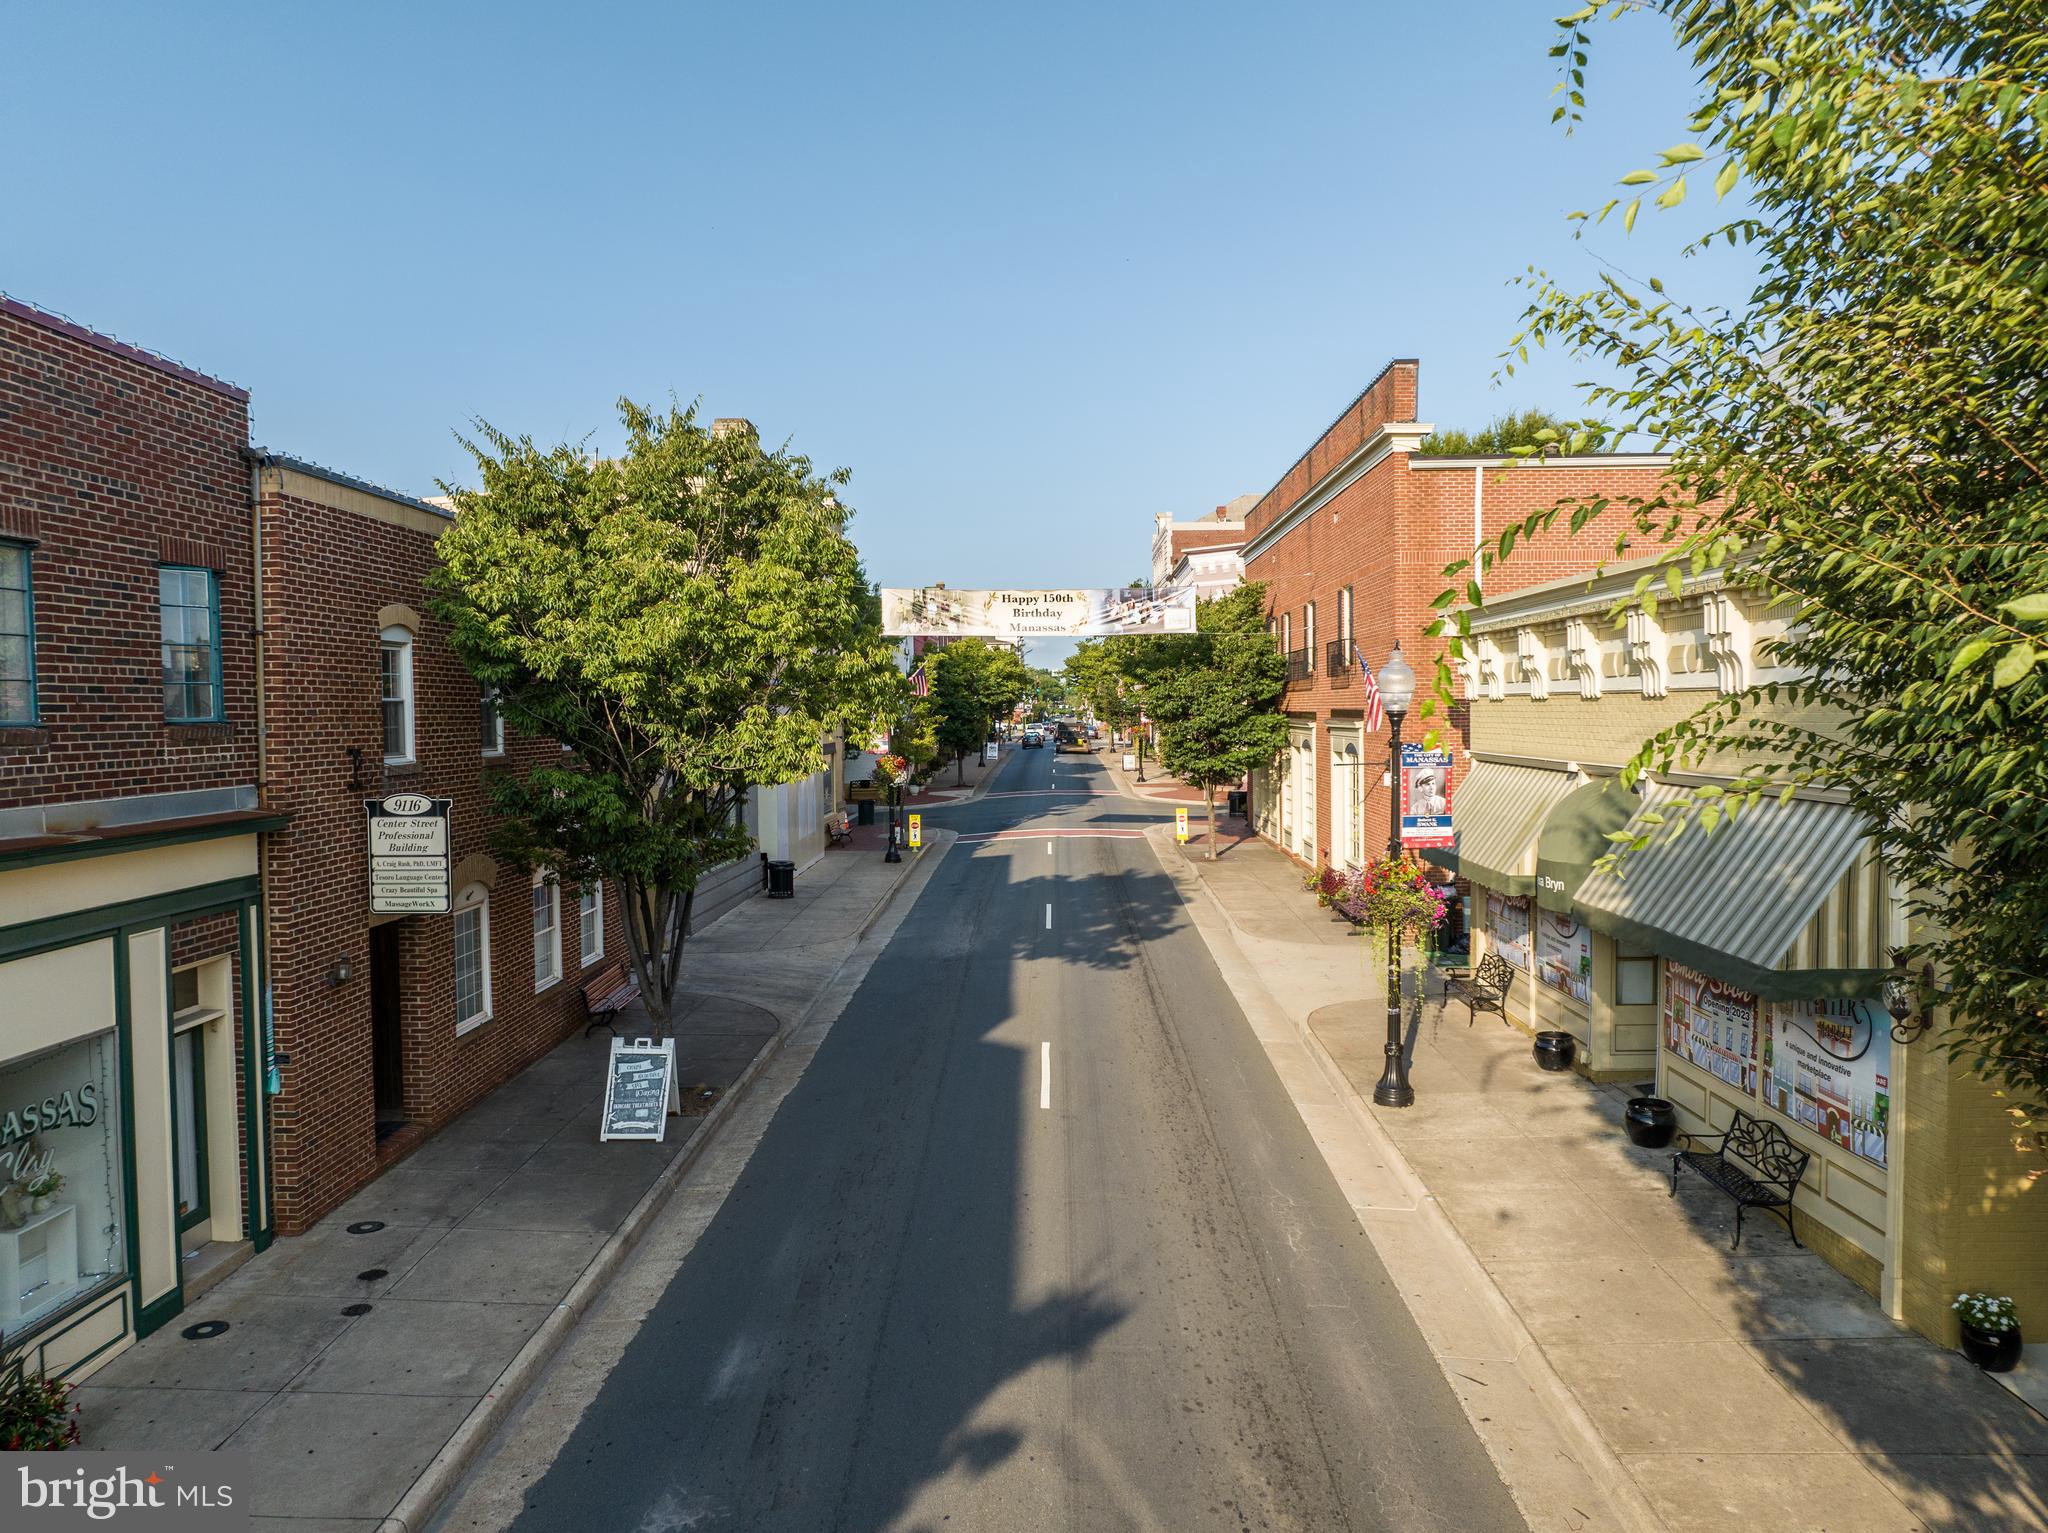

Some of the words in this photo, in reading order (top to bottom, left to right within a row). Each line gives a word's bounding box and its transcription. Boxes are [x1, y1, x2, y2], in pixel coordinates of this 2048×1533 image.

[1002, 594, 1039, 605] Happy
[1044, 594, 1073, 603] 150th
[1013, 608, 1063, 620] Birthday
[1009, 622, 1066, 632] Manassas
[393, 800, 421, 812] 9116
[377, 820, 407, 828] Center
[410, 820, 438, 828] Street
[378, 831, 434, 840] Professional
[389, 843, 429, 853] Building
[395, 874, 423, 882] Language
[426, 886, 438, 894] Spa
[1545, 876, 1565, 893] Bryn
[1703, 995, 1730, 1015] Opening
[1732, 1006, 1750, 1021] 2023
[1789, 1041, 1806, 1057] unique
[1806, 1050, 1818, 1061] and
[1818, 1054, 1852, 1077] innovative
[1797, 1059, 1832, 1082] marketplace
